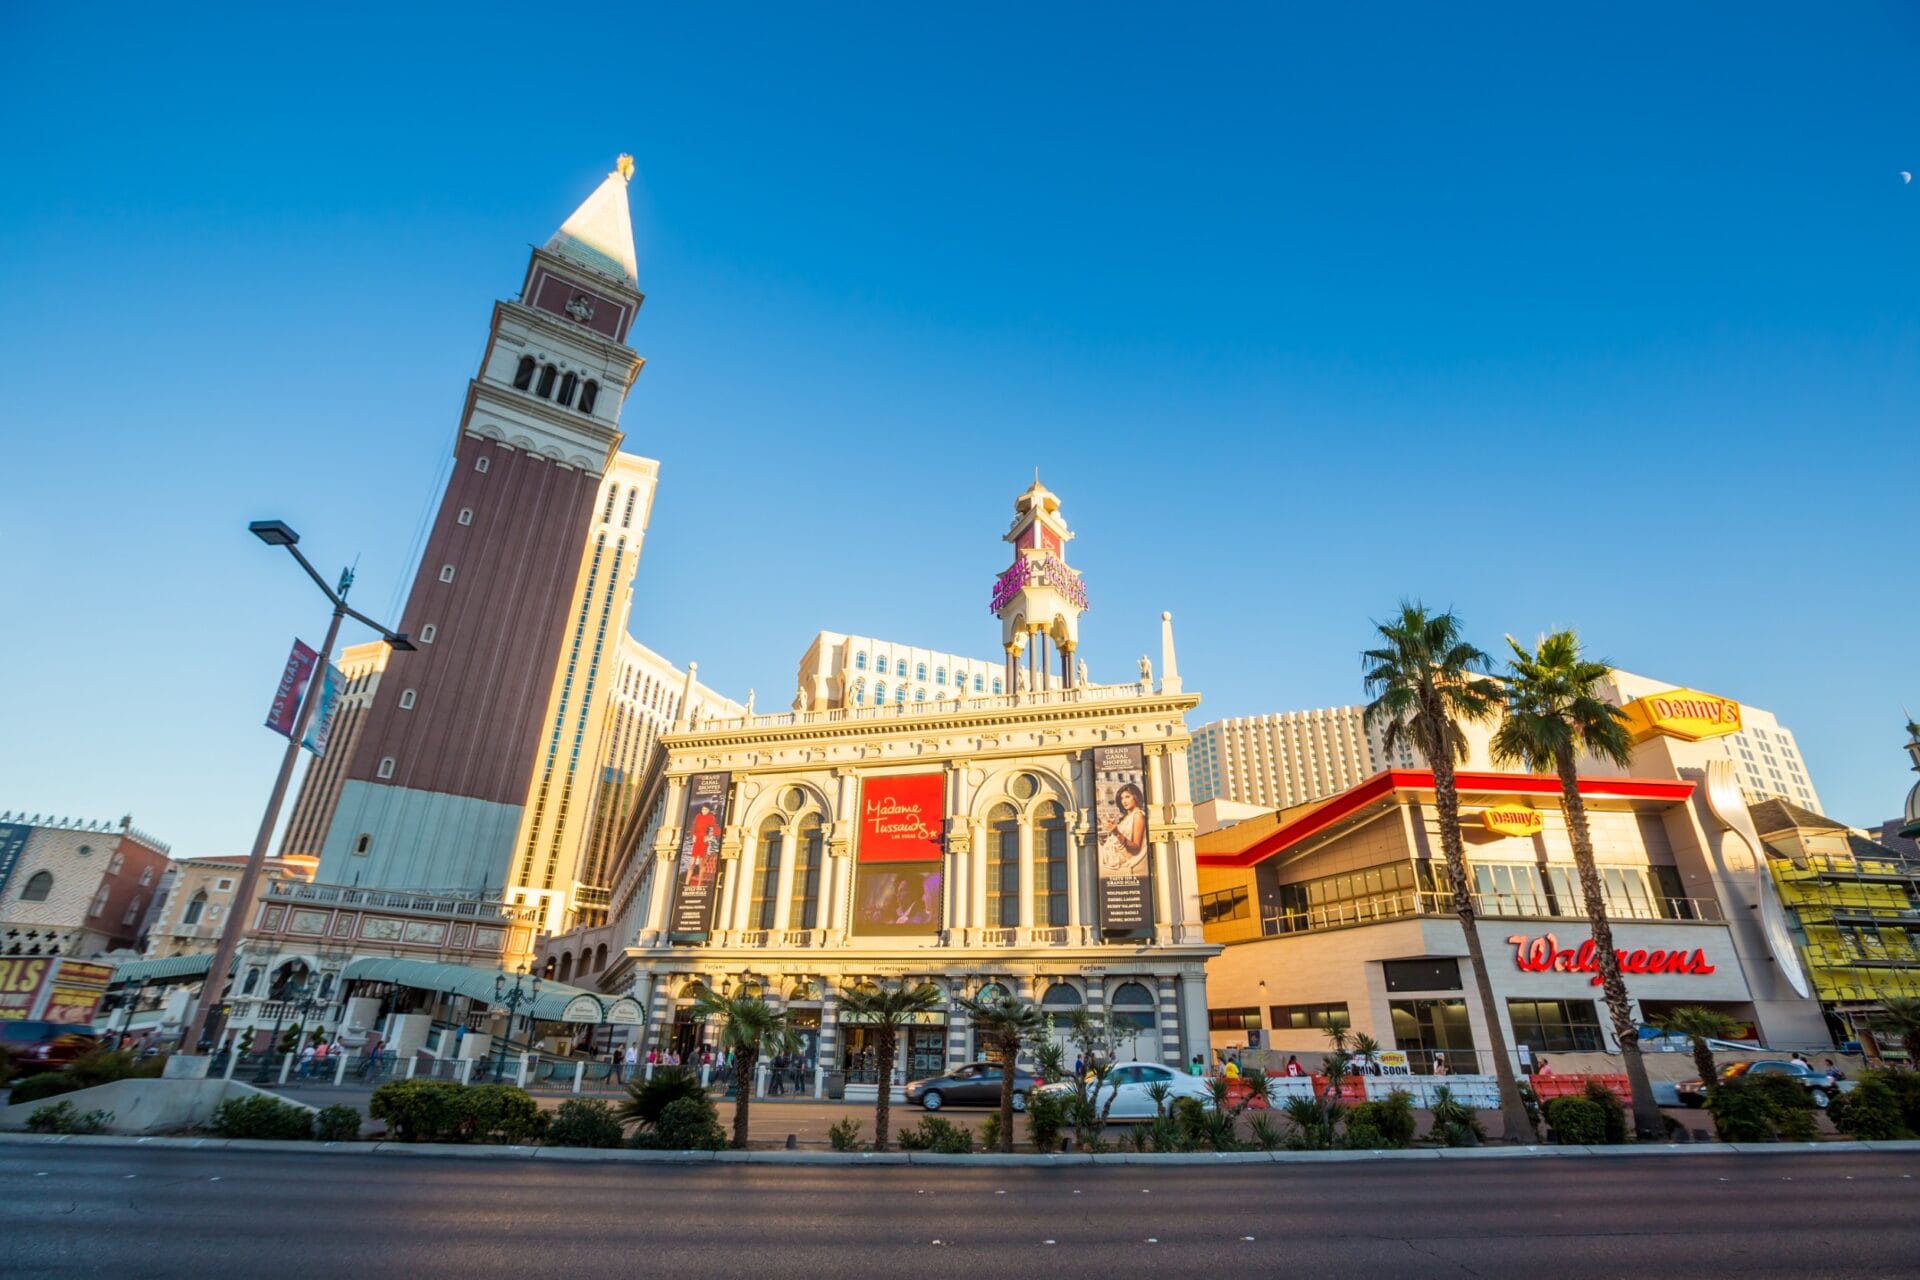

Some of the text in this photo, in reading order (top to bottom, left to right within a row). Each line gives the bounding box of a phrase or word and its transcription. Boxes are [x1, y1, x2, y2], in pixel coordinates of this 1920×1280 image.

[269, 659, 299, 725] LAS VEGAS
[1656, 697, 1739, 724] Denny's
[866, 796, 922, 817] Madame
[1490, 810, 1541, 827] Denny's
[868, 813, 929, 840] Tussauds
[1508, 933, 1715, 987] Walreens
[1383, 1066, 1408, 1075] SOON
